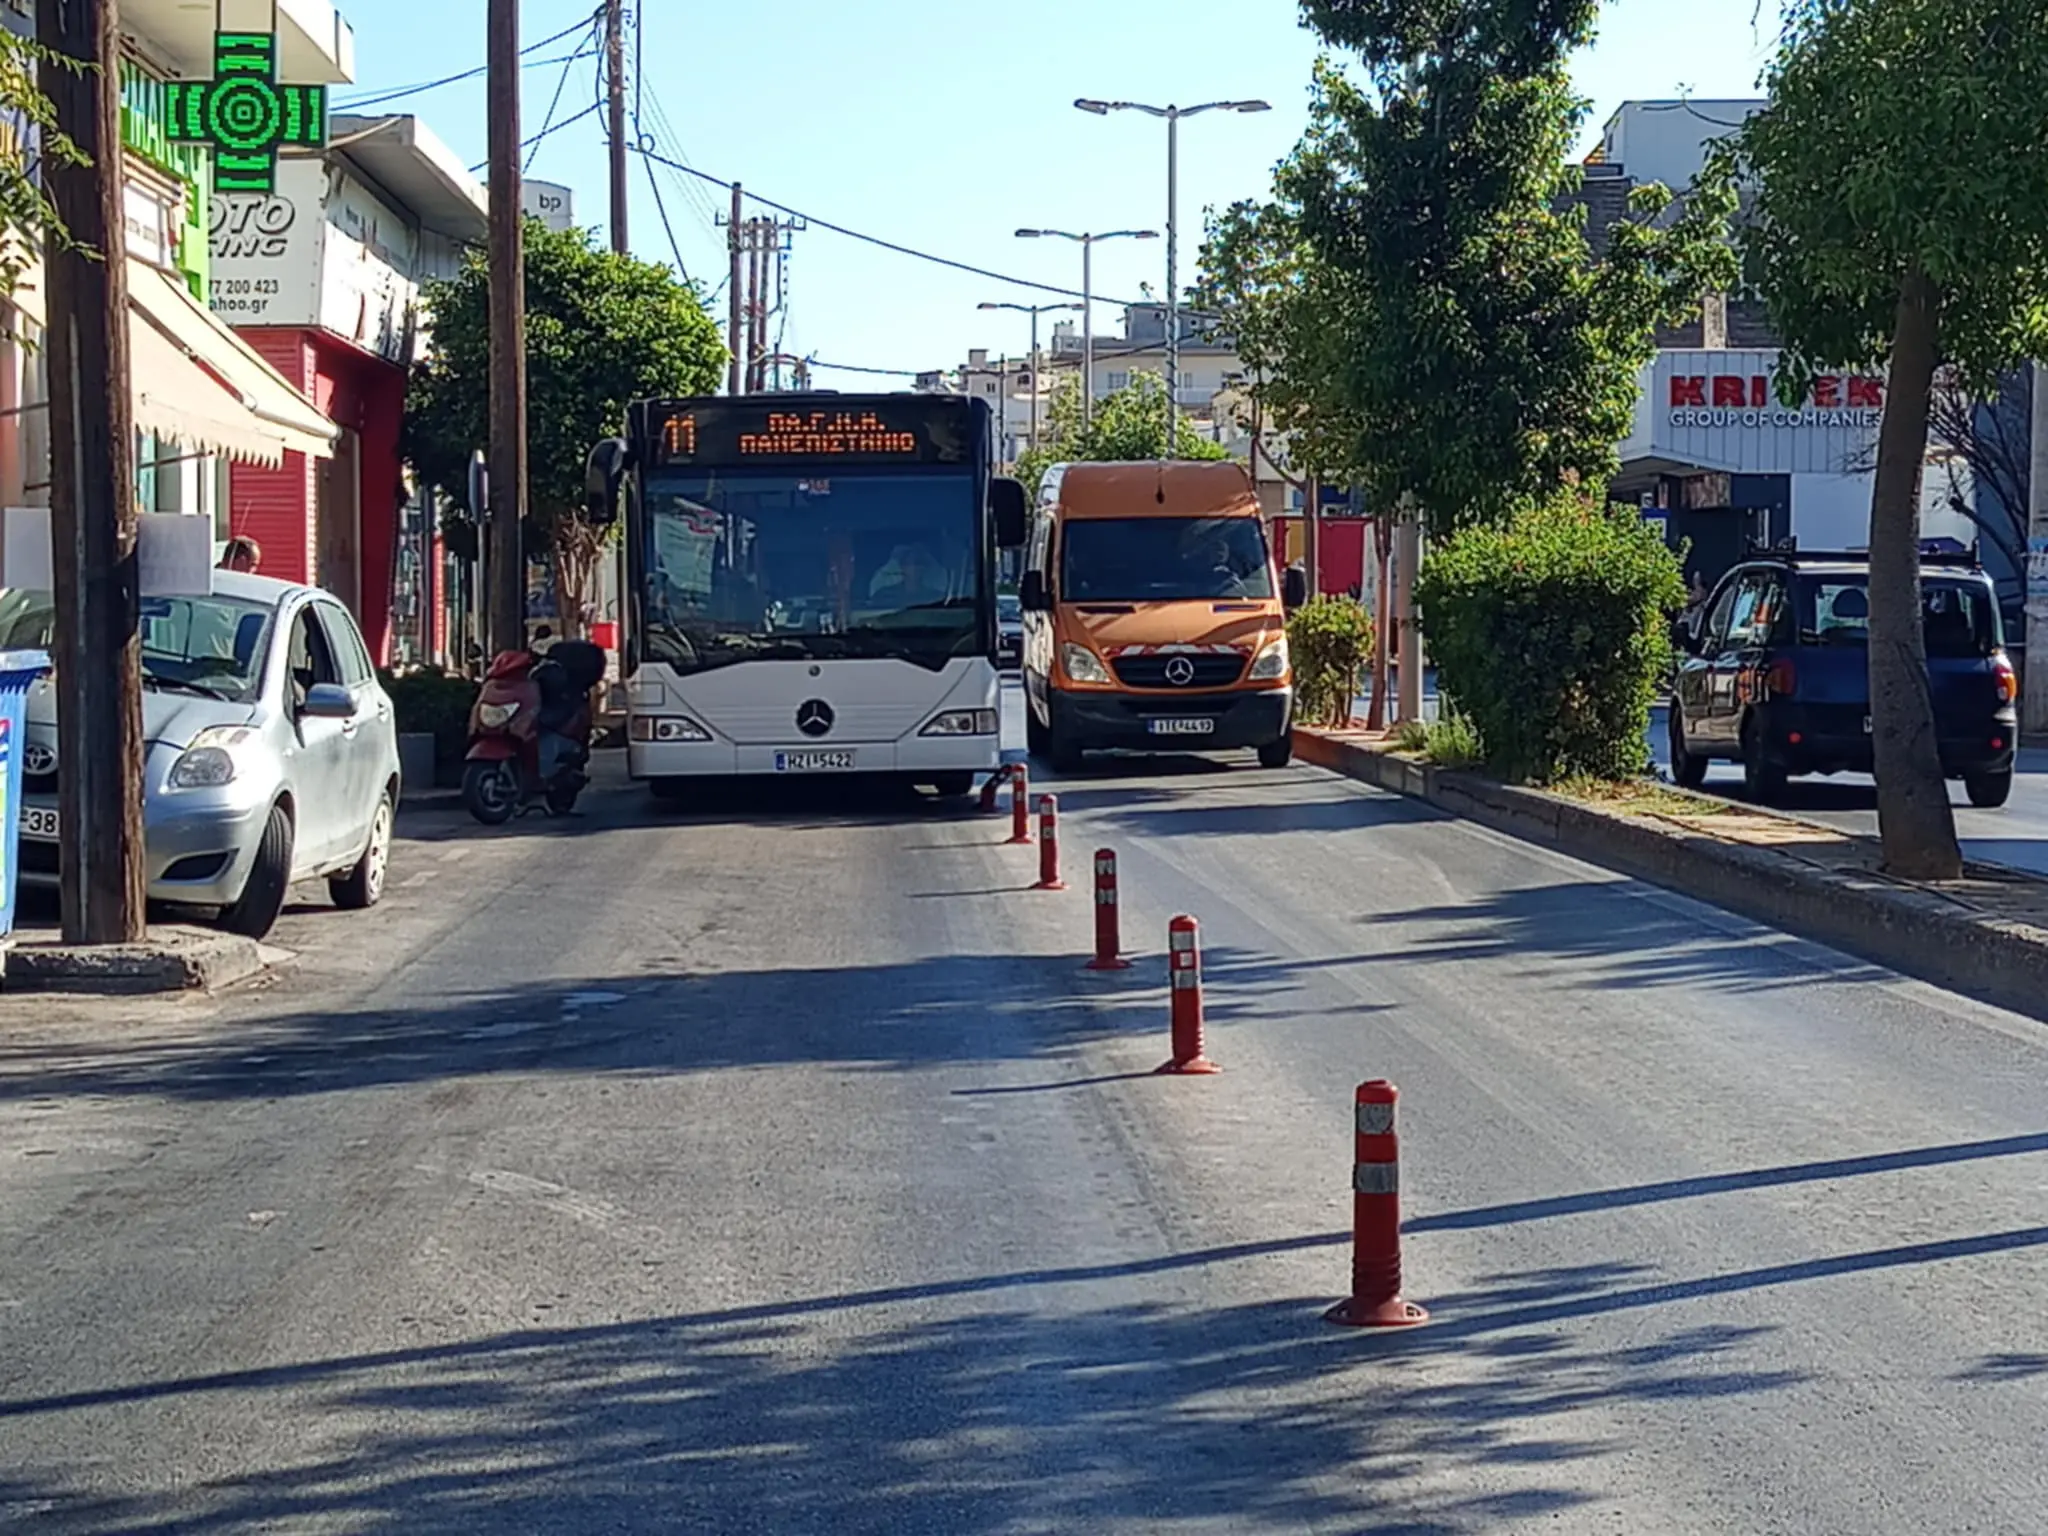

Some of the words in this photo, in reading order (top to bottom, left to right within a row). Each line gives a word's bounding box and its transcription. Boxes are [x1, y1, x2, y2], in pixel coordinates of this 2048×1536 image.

[539, 193, 562, 212] bp
[226, 280, 250, 294] 200
[254, 280, 279, 294] 423
[1670, 375, 1882, 407] KRIEK
[1670, 411, 1738, 428] GROUP
[1743, 411, 1768, 428] OF
[665, 414, 695, 454] 11
